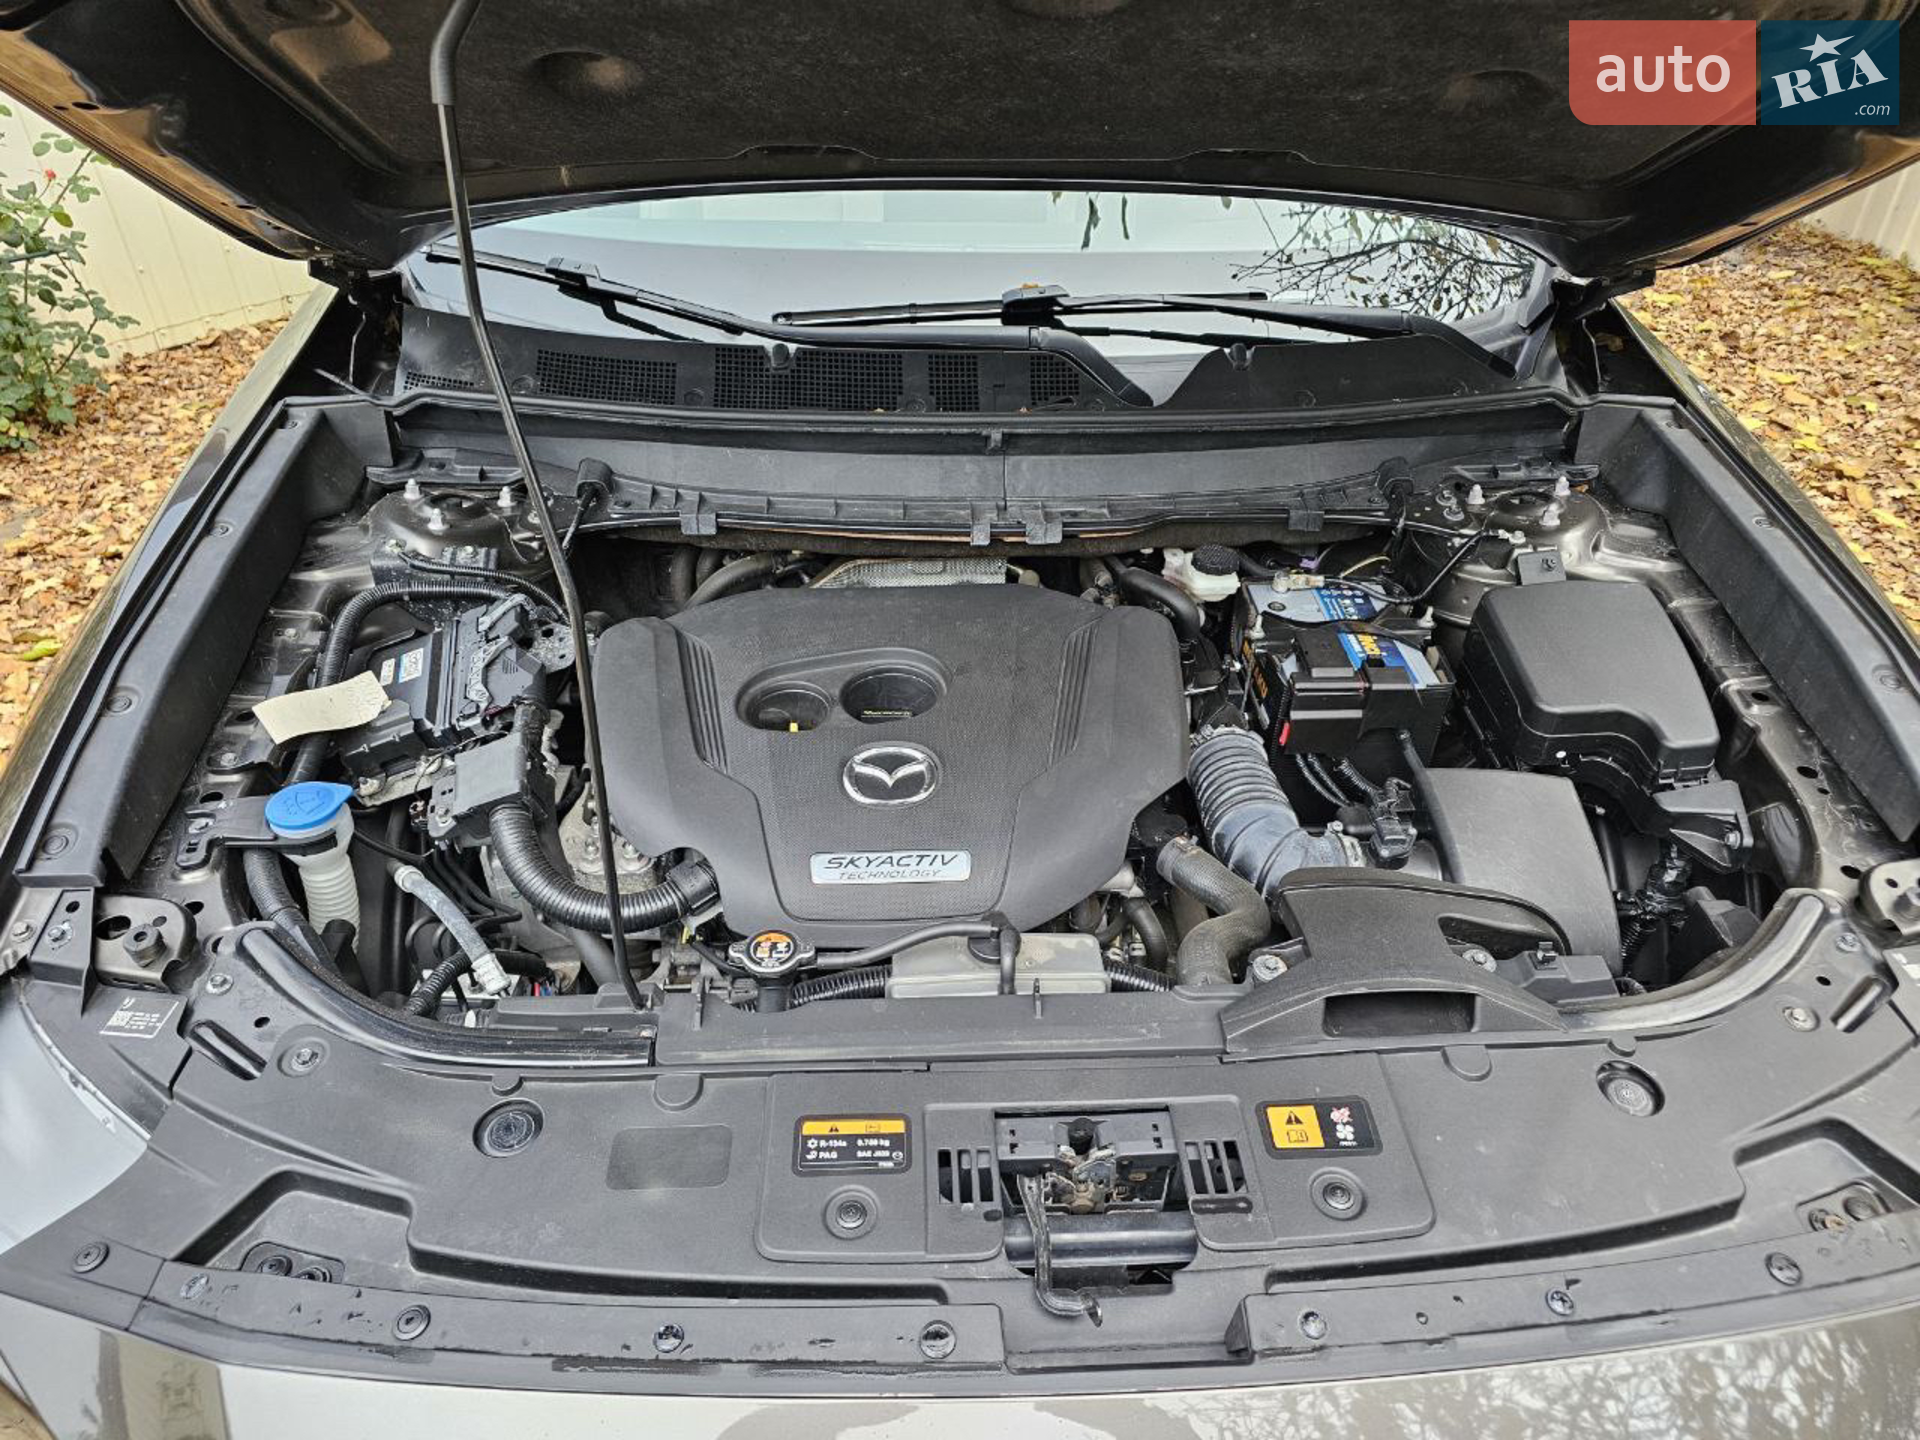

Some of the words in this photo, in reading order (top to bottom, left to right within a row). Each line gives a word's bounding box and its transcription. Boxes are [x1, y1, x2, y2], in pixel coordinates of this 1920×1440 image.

[824, 854, 958, 869] SKYACTIV
[839, 869, 942, 880] TECHNOLOGY
[818, 1151, 838, 1159] PAG
